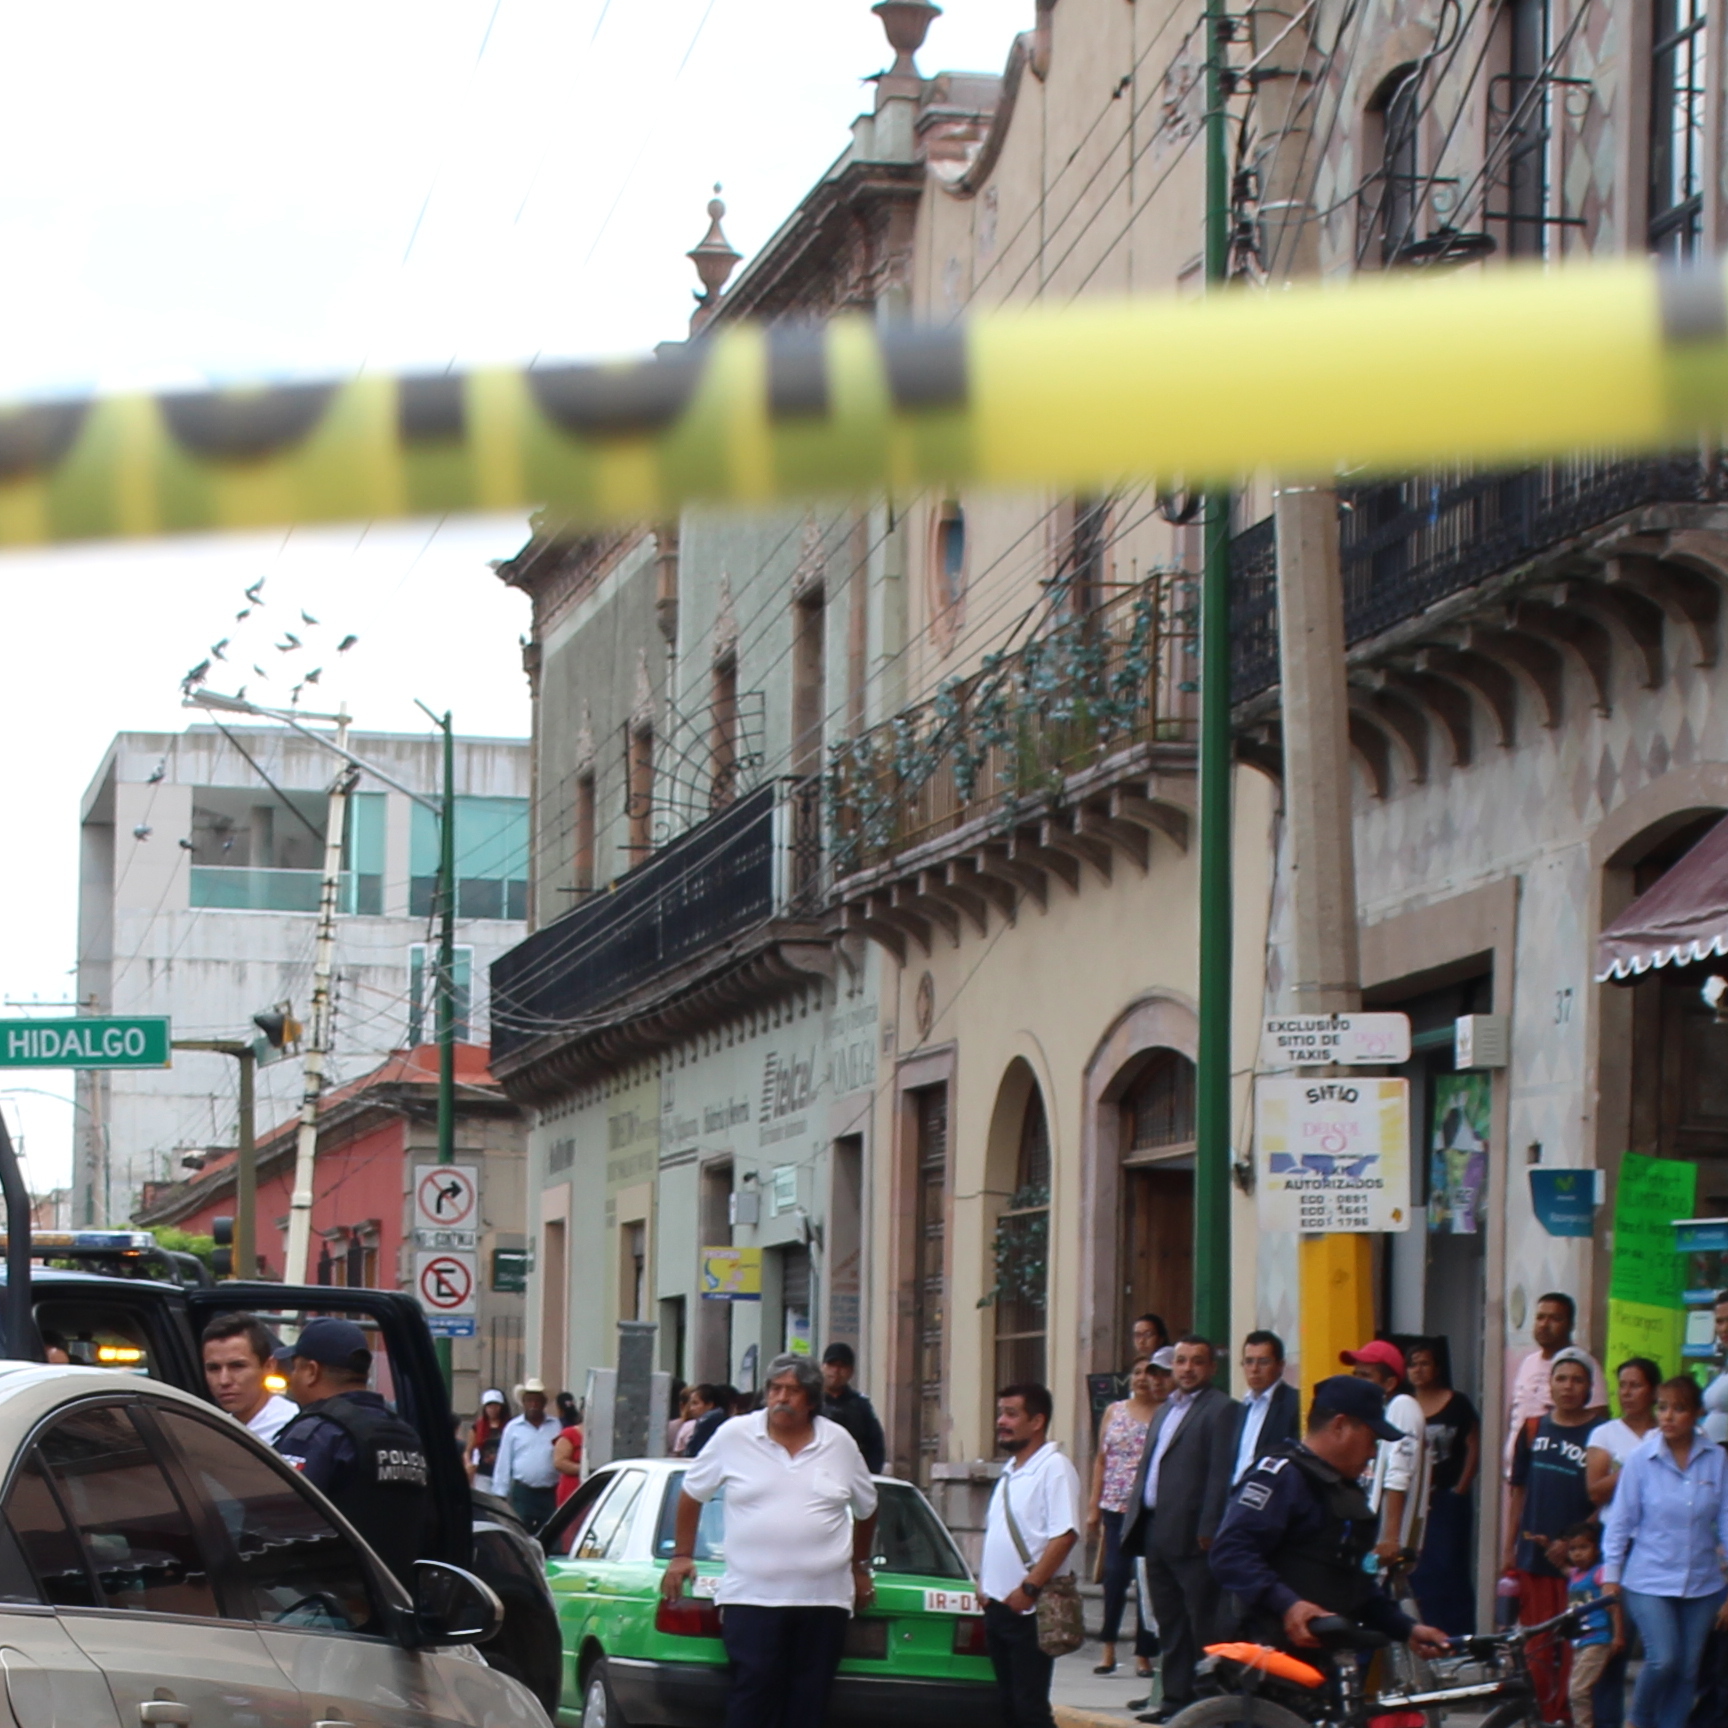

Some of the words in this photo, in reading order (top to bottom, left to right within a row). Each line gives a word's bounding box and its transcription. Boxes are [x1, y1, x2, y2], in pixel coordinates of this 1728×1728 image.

[1267, 1019, 1351, 1032] EXCLUSIVO
[8, 1028, 146, 1058] HIDALGO
[1277, 1035, 1316, 1046] SITIO
[1322, 1034, 1341, 1045] DE
[1288, 1050, 1331, 1061] TAXIS
[1306, 1085, 1359, 1104] SITIO
[1284, 1178, 1384, 1190] AUTORIZADOS
[1300, 1194, 1325, 1204] ECO
[1300, 1206, 1325, 1216] ECO
